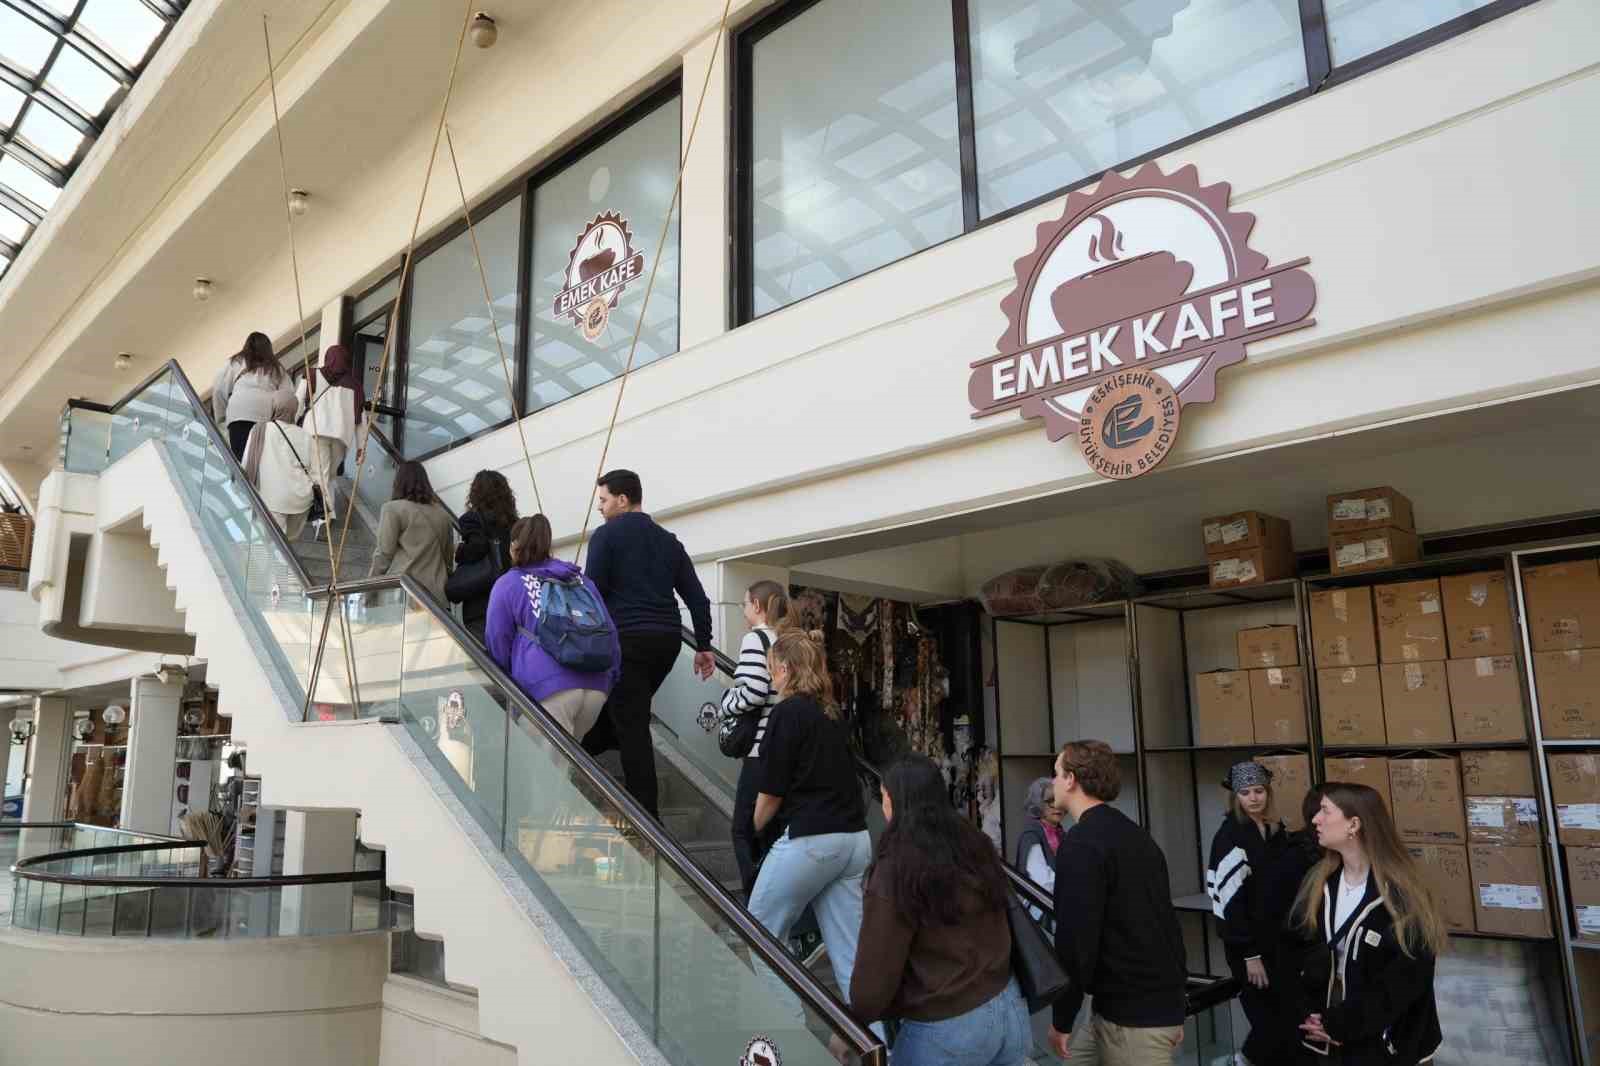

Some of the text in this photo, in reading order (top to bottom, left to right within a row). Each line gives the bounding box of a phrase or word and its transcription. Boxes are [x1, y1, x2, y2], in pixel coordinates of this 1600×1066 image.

[561, 260, 636, 312] EMEK KAFE
[992, 278, 1276, 401] EMEK KAFE
[1092, 371, 1154, 404] ESKİŞEHİR
[1080, 395, 1175, 475] BÜYÜKŞEHİR BELEDİYESİ
